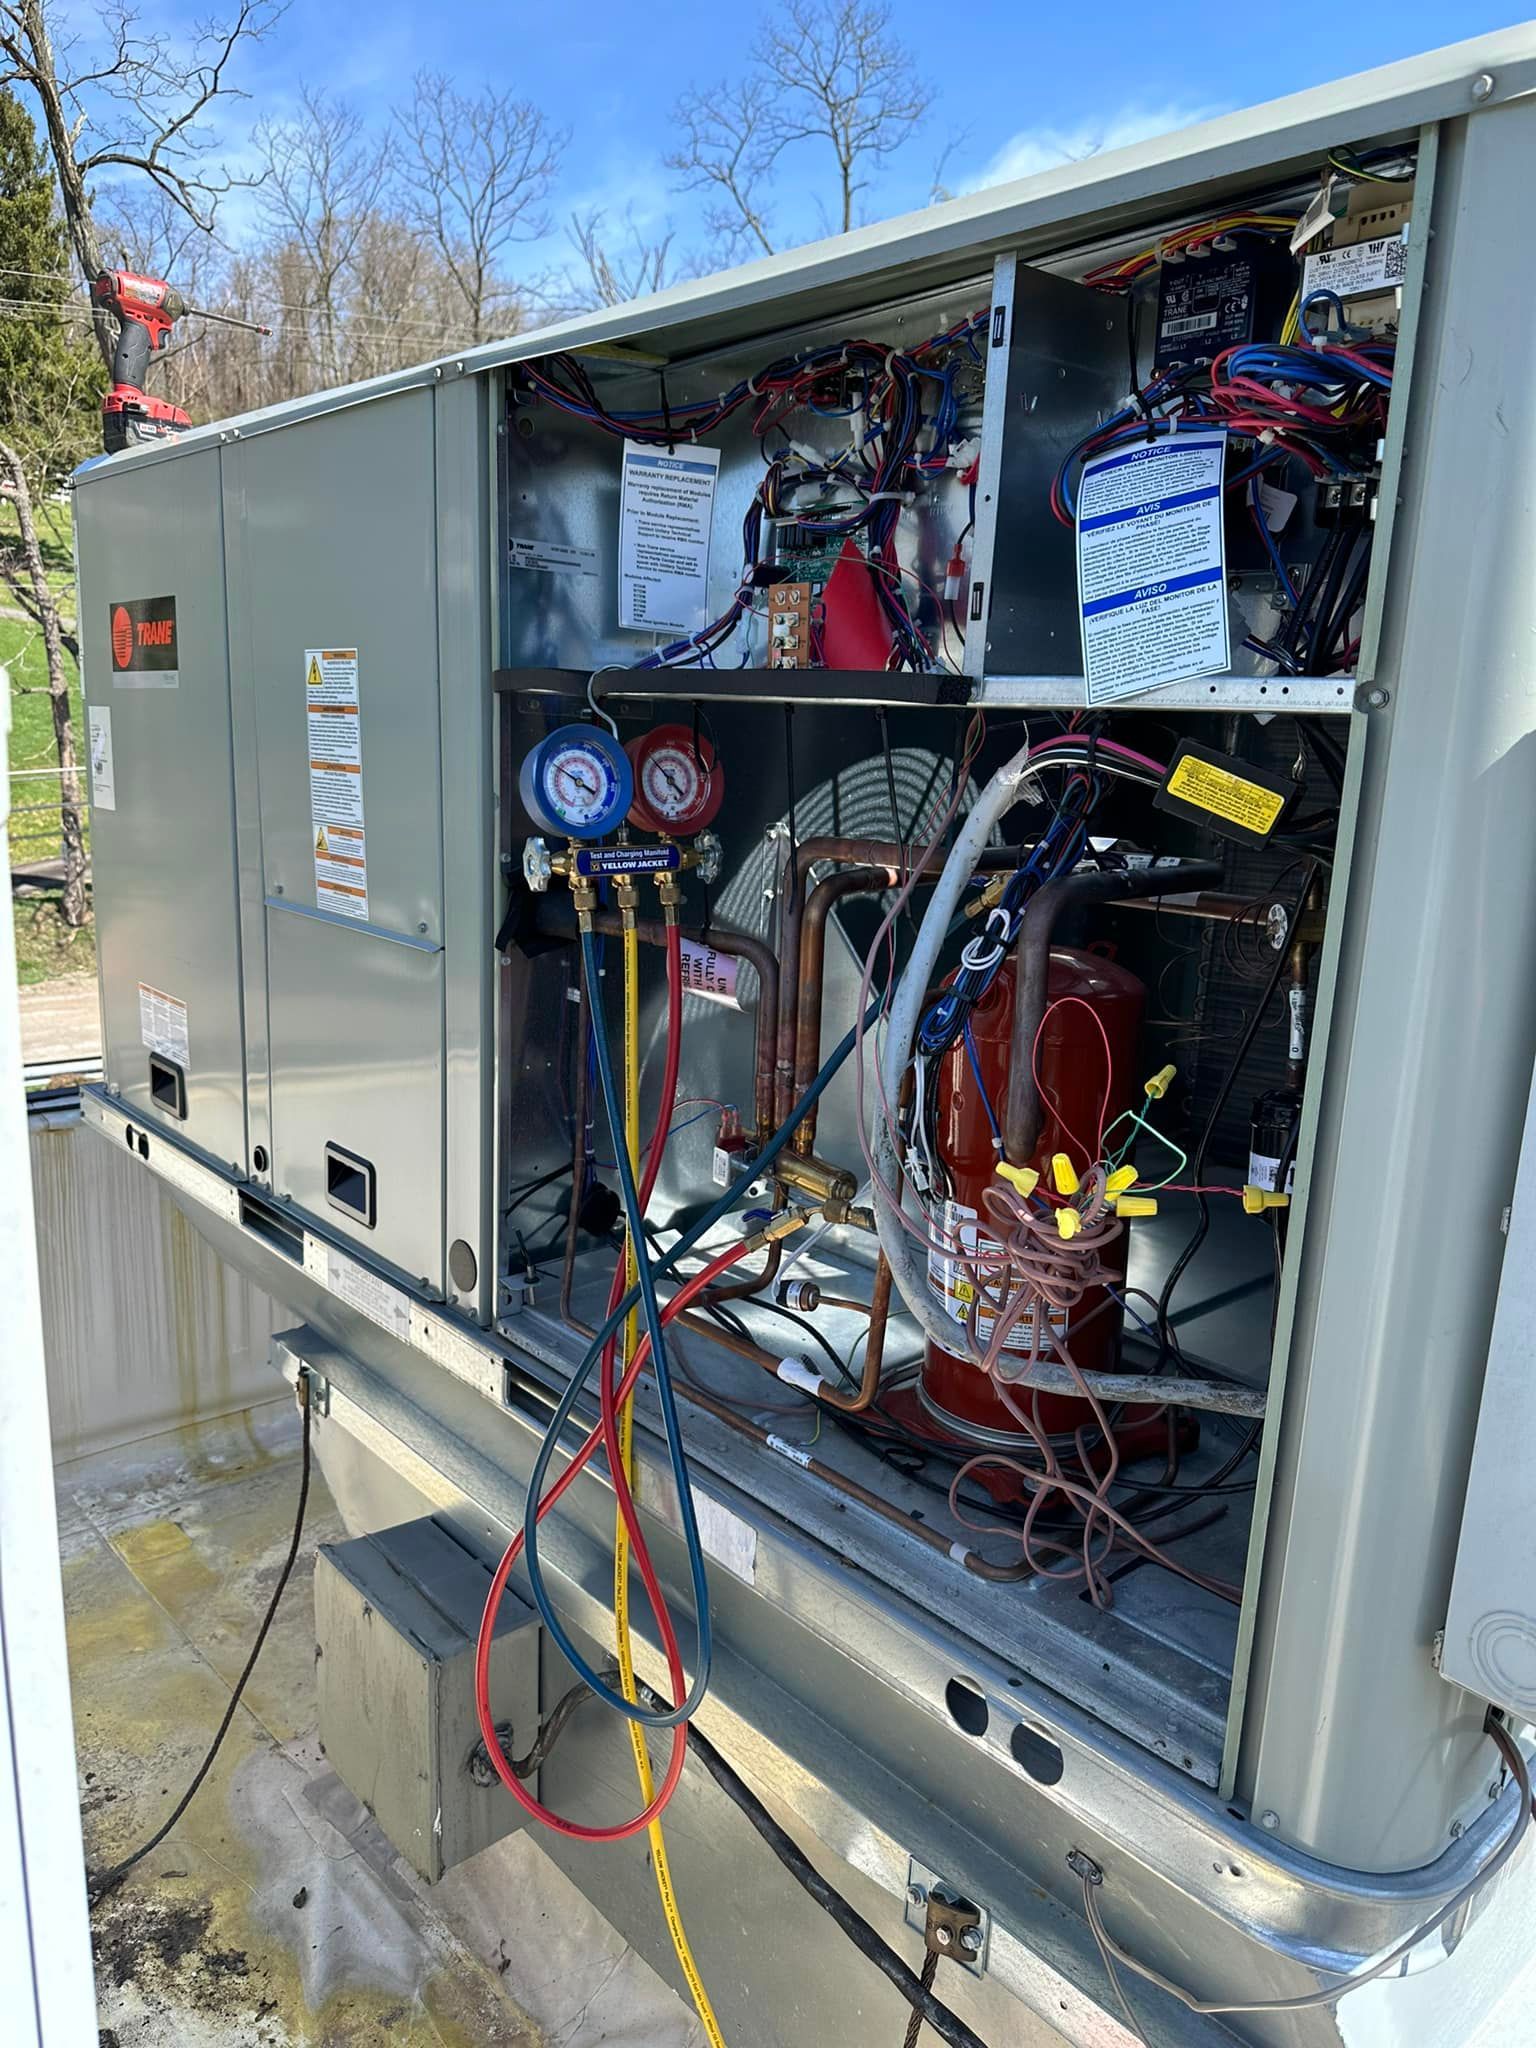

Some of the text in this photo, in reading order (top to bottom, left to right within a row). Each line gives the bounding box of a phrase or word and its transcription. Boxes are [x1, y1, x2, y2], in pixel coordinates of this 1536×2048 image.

[1163, 305, 1187, 317] TRANE
[1130, 445, 1172, 461] NOTICE
[657, 459, 684, 470] NOTICE
[1124, 460, 1146, 472] PHASE
[1147, 453, 1178, 465] MONITOR
[629, 469, 711, 486] WARRANTY REPLACEMENT
[1126, 516, 1153, 527] VOYANT
[1165, 503, 1201, 517] MONITEUR
[1202, 500, 1212, 508] DE
[1135, 502, 1161, 516] AVIS
[1134, 583, 1167, 600] AVISO
[1135, 602, 1148, 611] LUZ
[1149, 598, 1162, 606] DEL
[1163, 590, 1196, 602] MONITOR
[1207, 583, 1217, 591] LA
[137, 619, 172, 646] TRANE
[590, 851, 603, 859] Test
[616, 849, 643, 858] Charging
[643, 848, 670, 856] Manifold
[601, 859, 669, 870] YELLOW JACKET
[693, 958, 703, 986] WITH
[705, 951, 717, 982] FULLY
[670, 1916, 679, 1937] Charging
